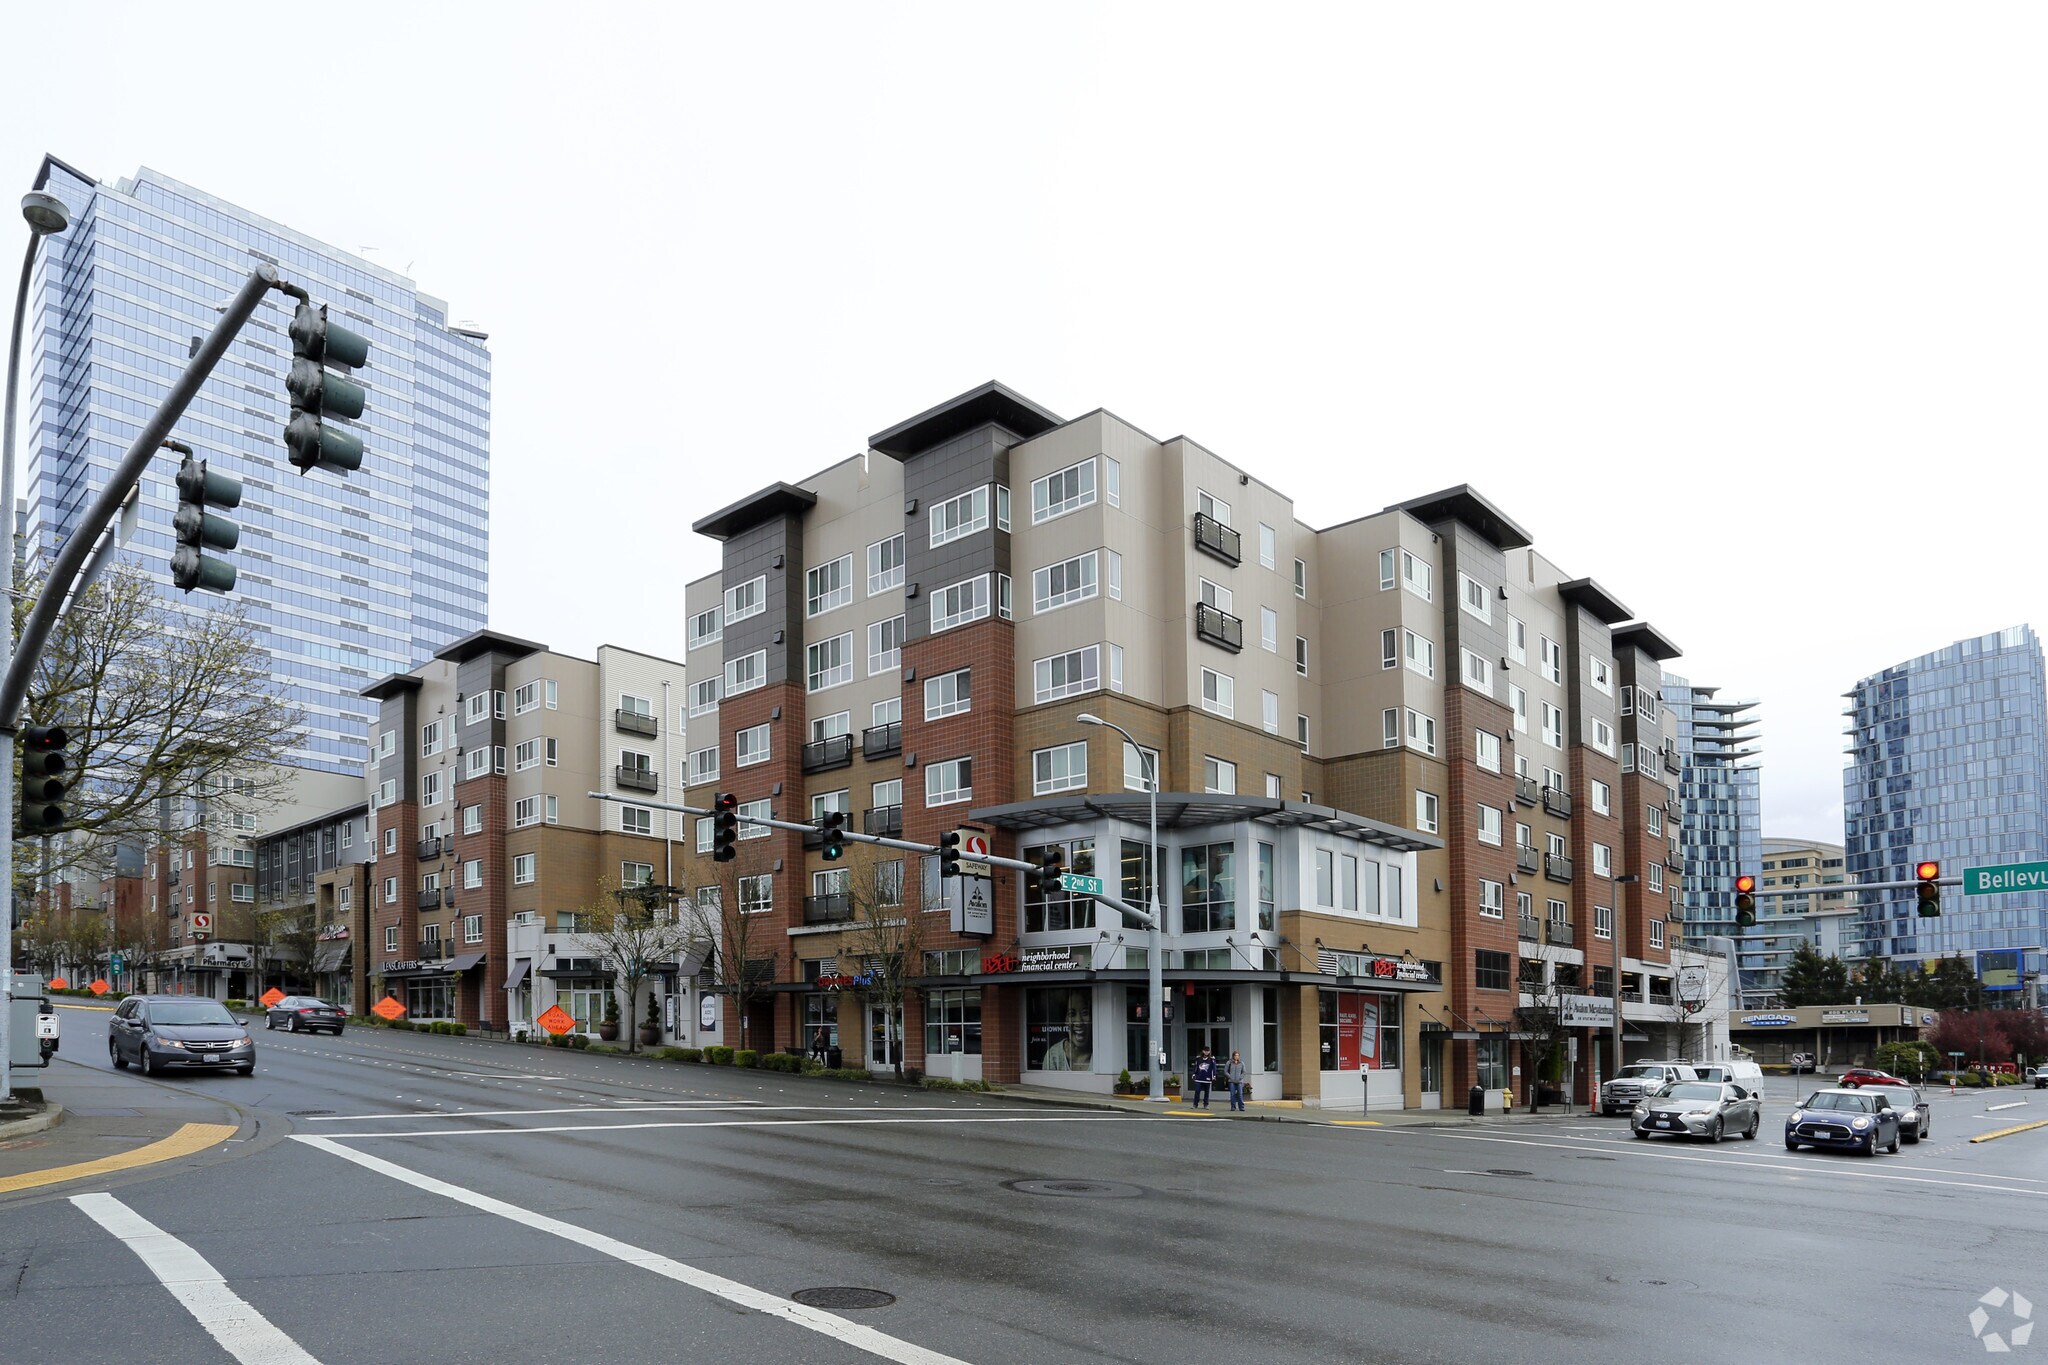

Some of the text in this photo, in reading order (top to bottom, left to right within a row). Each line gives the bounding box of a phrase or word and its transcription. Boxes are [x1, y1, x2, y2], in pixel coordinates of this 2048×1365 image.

[966, 862, 988, 871] SAFEWAY
[1071, 877, 1084, 889] 2nd
[1088, 879, 1097, 892] St
[1978, 870, 2048, 889] Bellevu
[968, 900, 988, 909] Avalon
[202, 958, 241, 969] Pharmacy
[1021, 951, 1071, 965] neighborhood
[1021, 961, 1078, 972] financial center
[1397, 961, 1425, 972] neighborhood
[1741, 1014, 1798, 1024] RENEGADE
